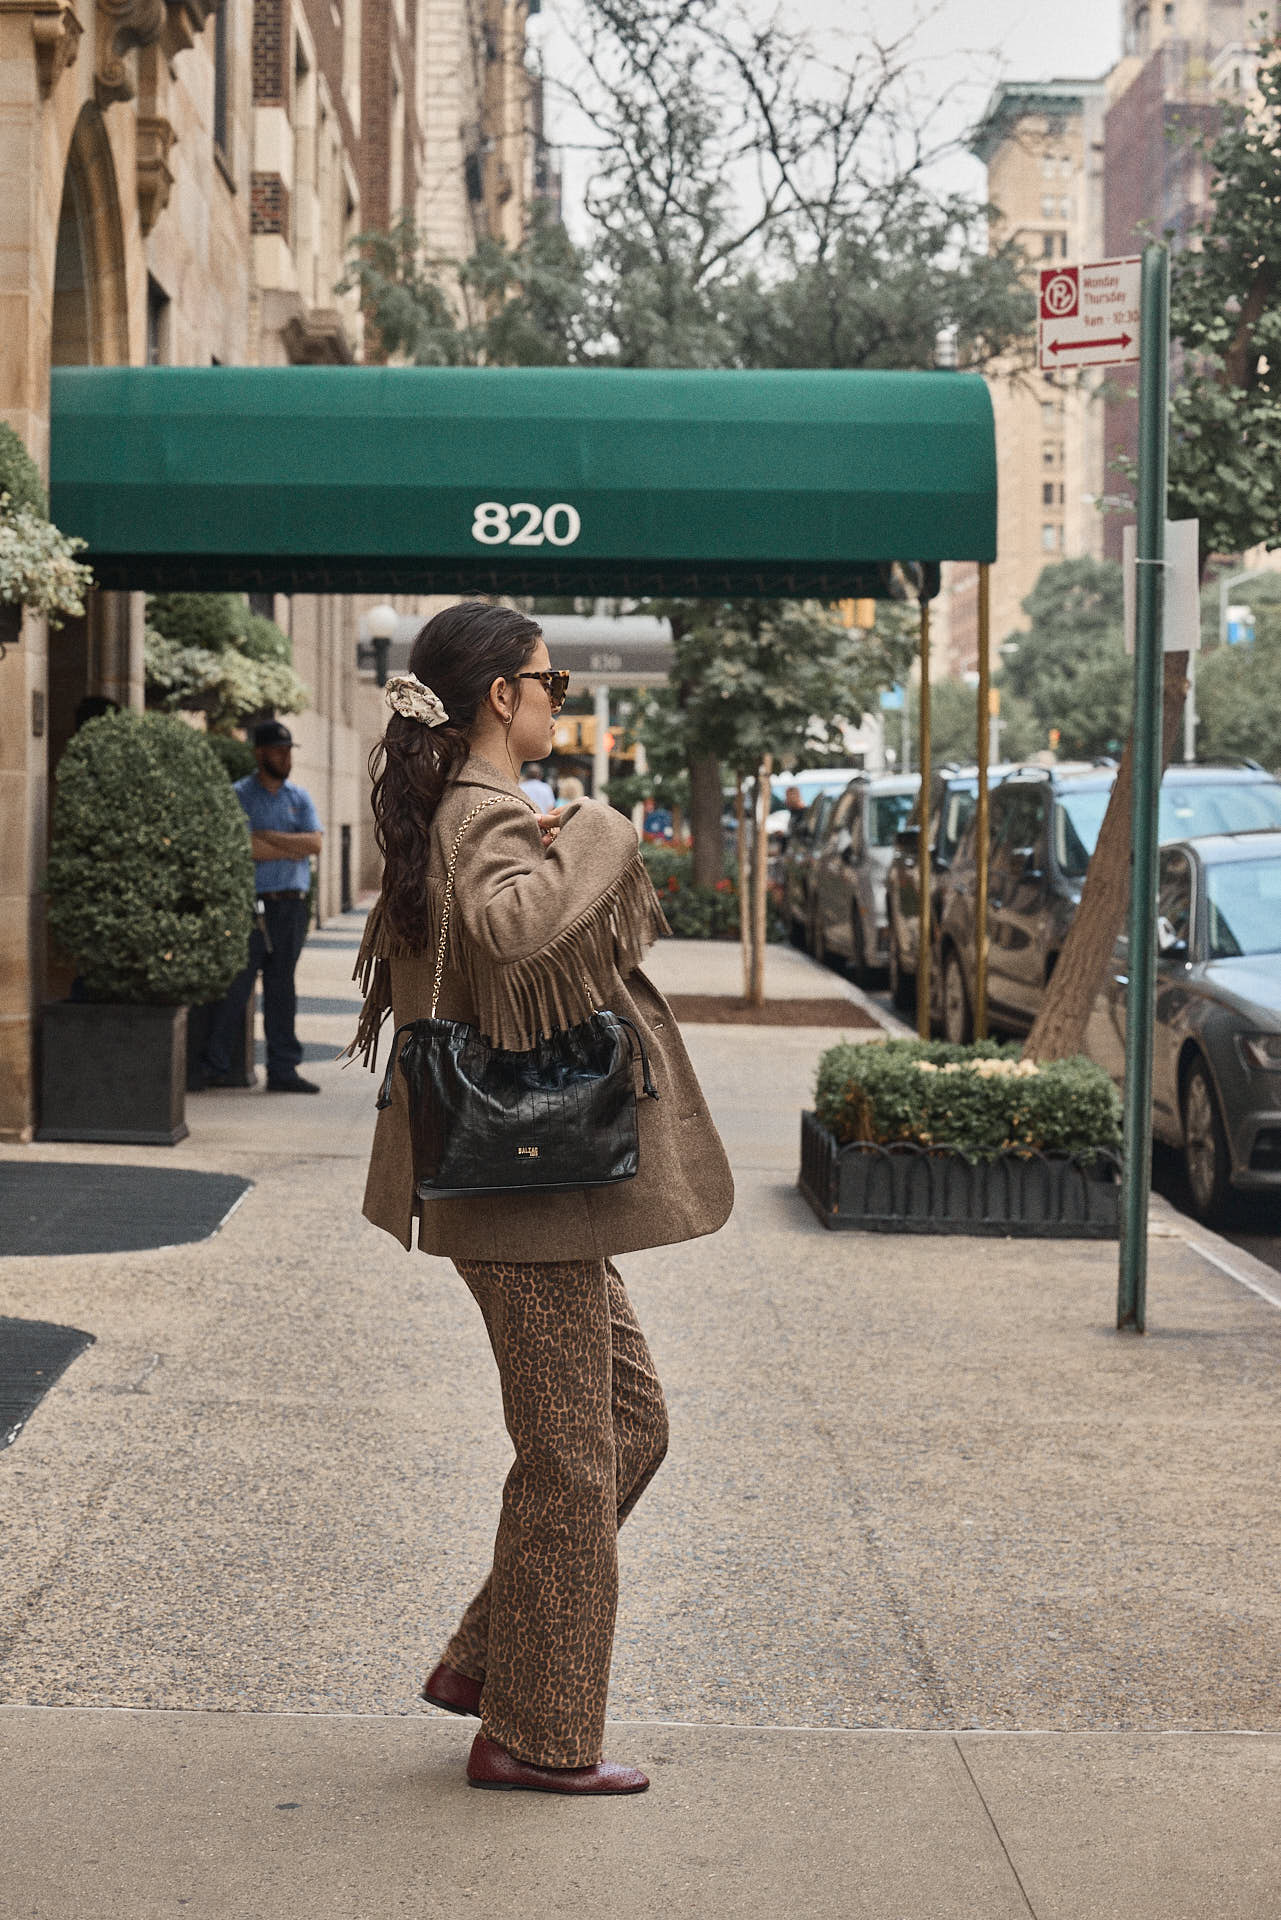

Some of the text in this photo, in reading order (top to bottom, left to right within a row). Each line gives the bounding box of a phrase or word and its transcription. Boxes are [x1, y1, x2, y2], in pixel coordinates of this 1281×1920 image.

[1083, 276, 1120, 288] Monday
[1084, 291, 1126, 304] Thursday
[472, 502, 581, 546] 820
